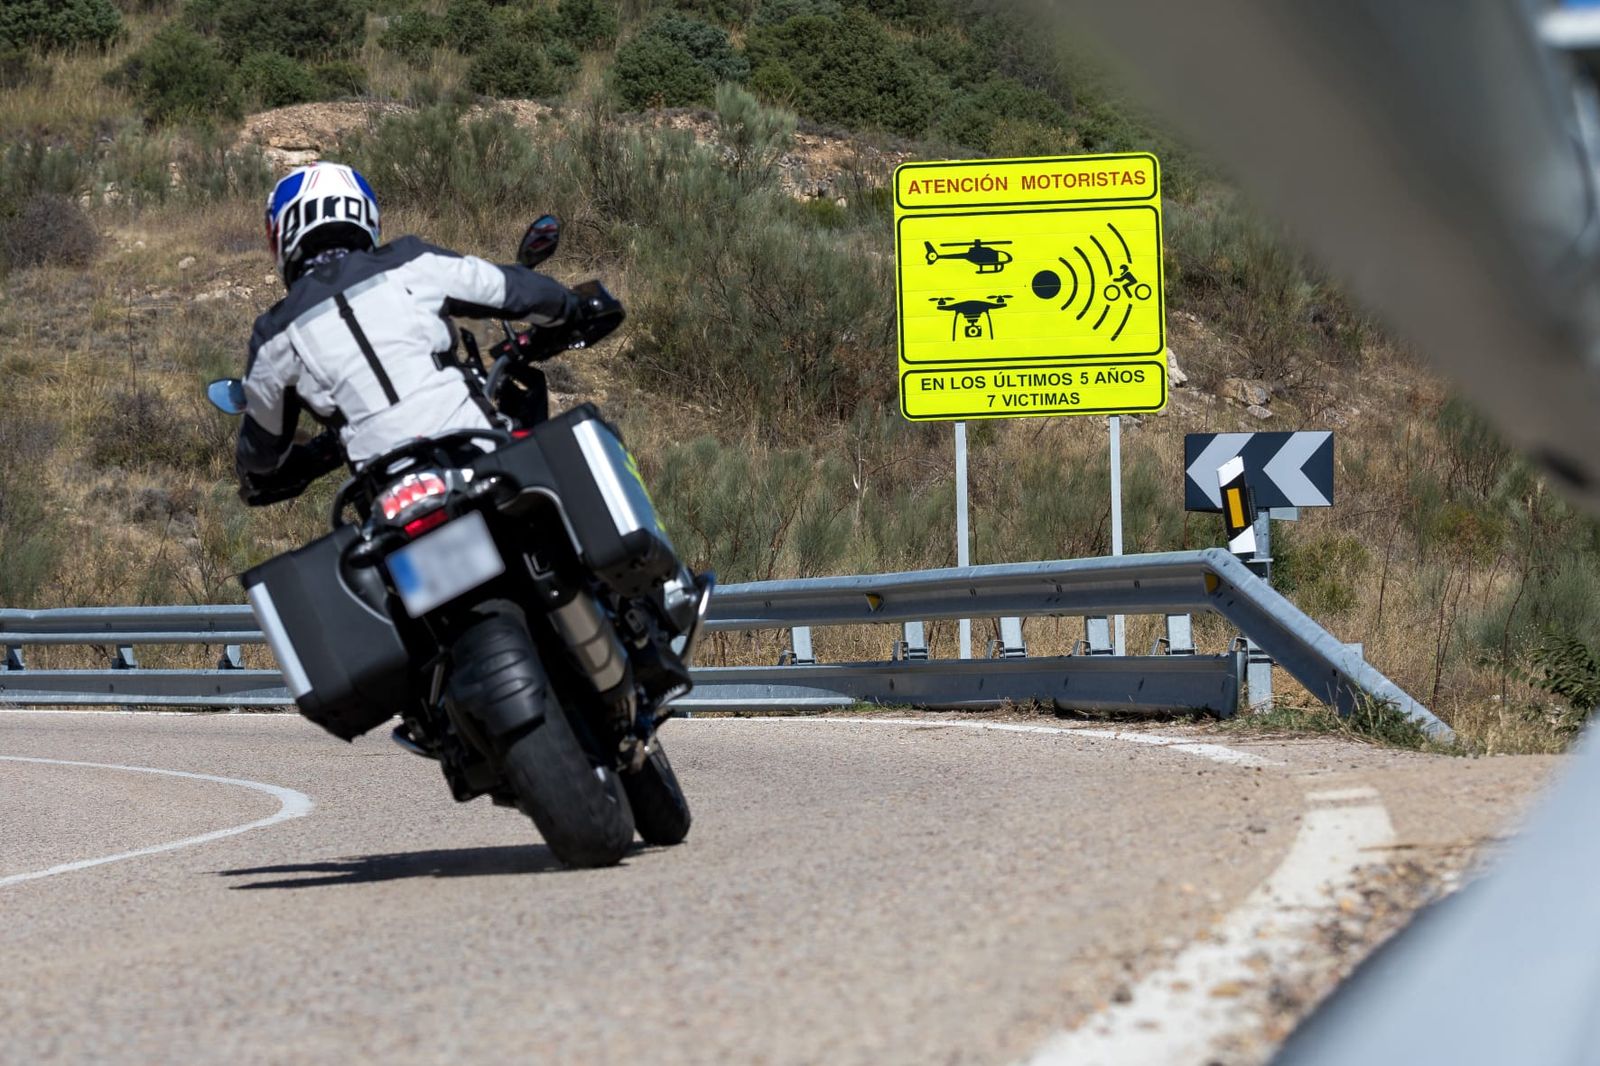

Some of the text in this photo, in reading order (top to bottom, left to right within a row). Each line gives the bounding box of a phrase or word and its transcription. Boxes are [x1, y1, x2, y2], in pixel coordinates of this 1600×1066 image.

[908, 170, 1146, 195] ATENCIÓN MOTORISTAS
[921, 367, 1146, 391] EN LOS ÚLTIMOS 5 AÑOS
[987, 392, 1081, 408] 7 VICTIMAS
